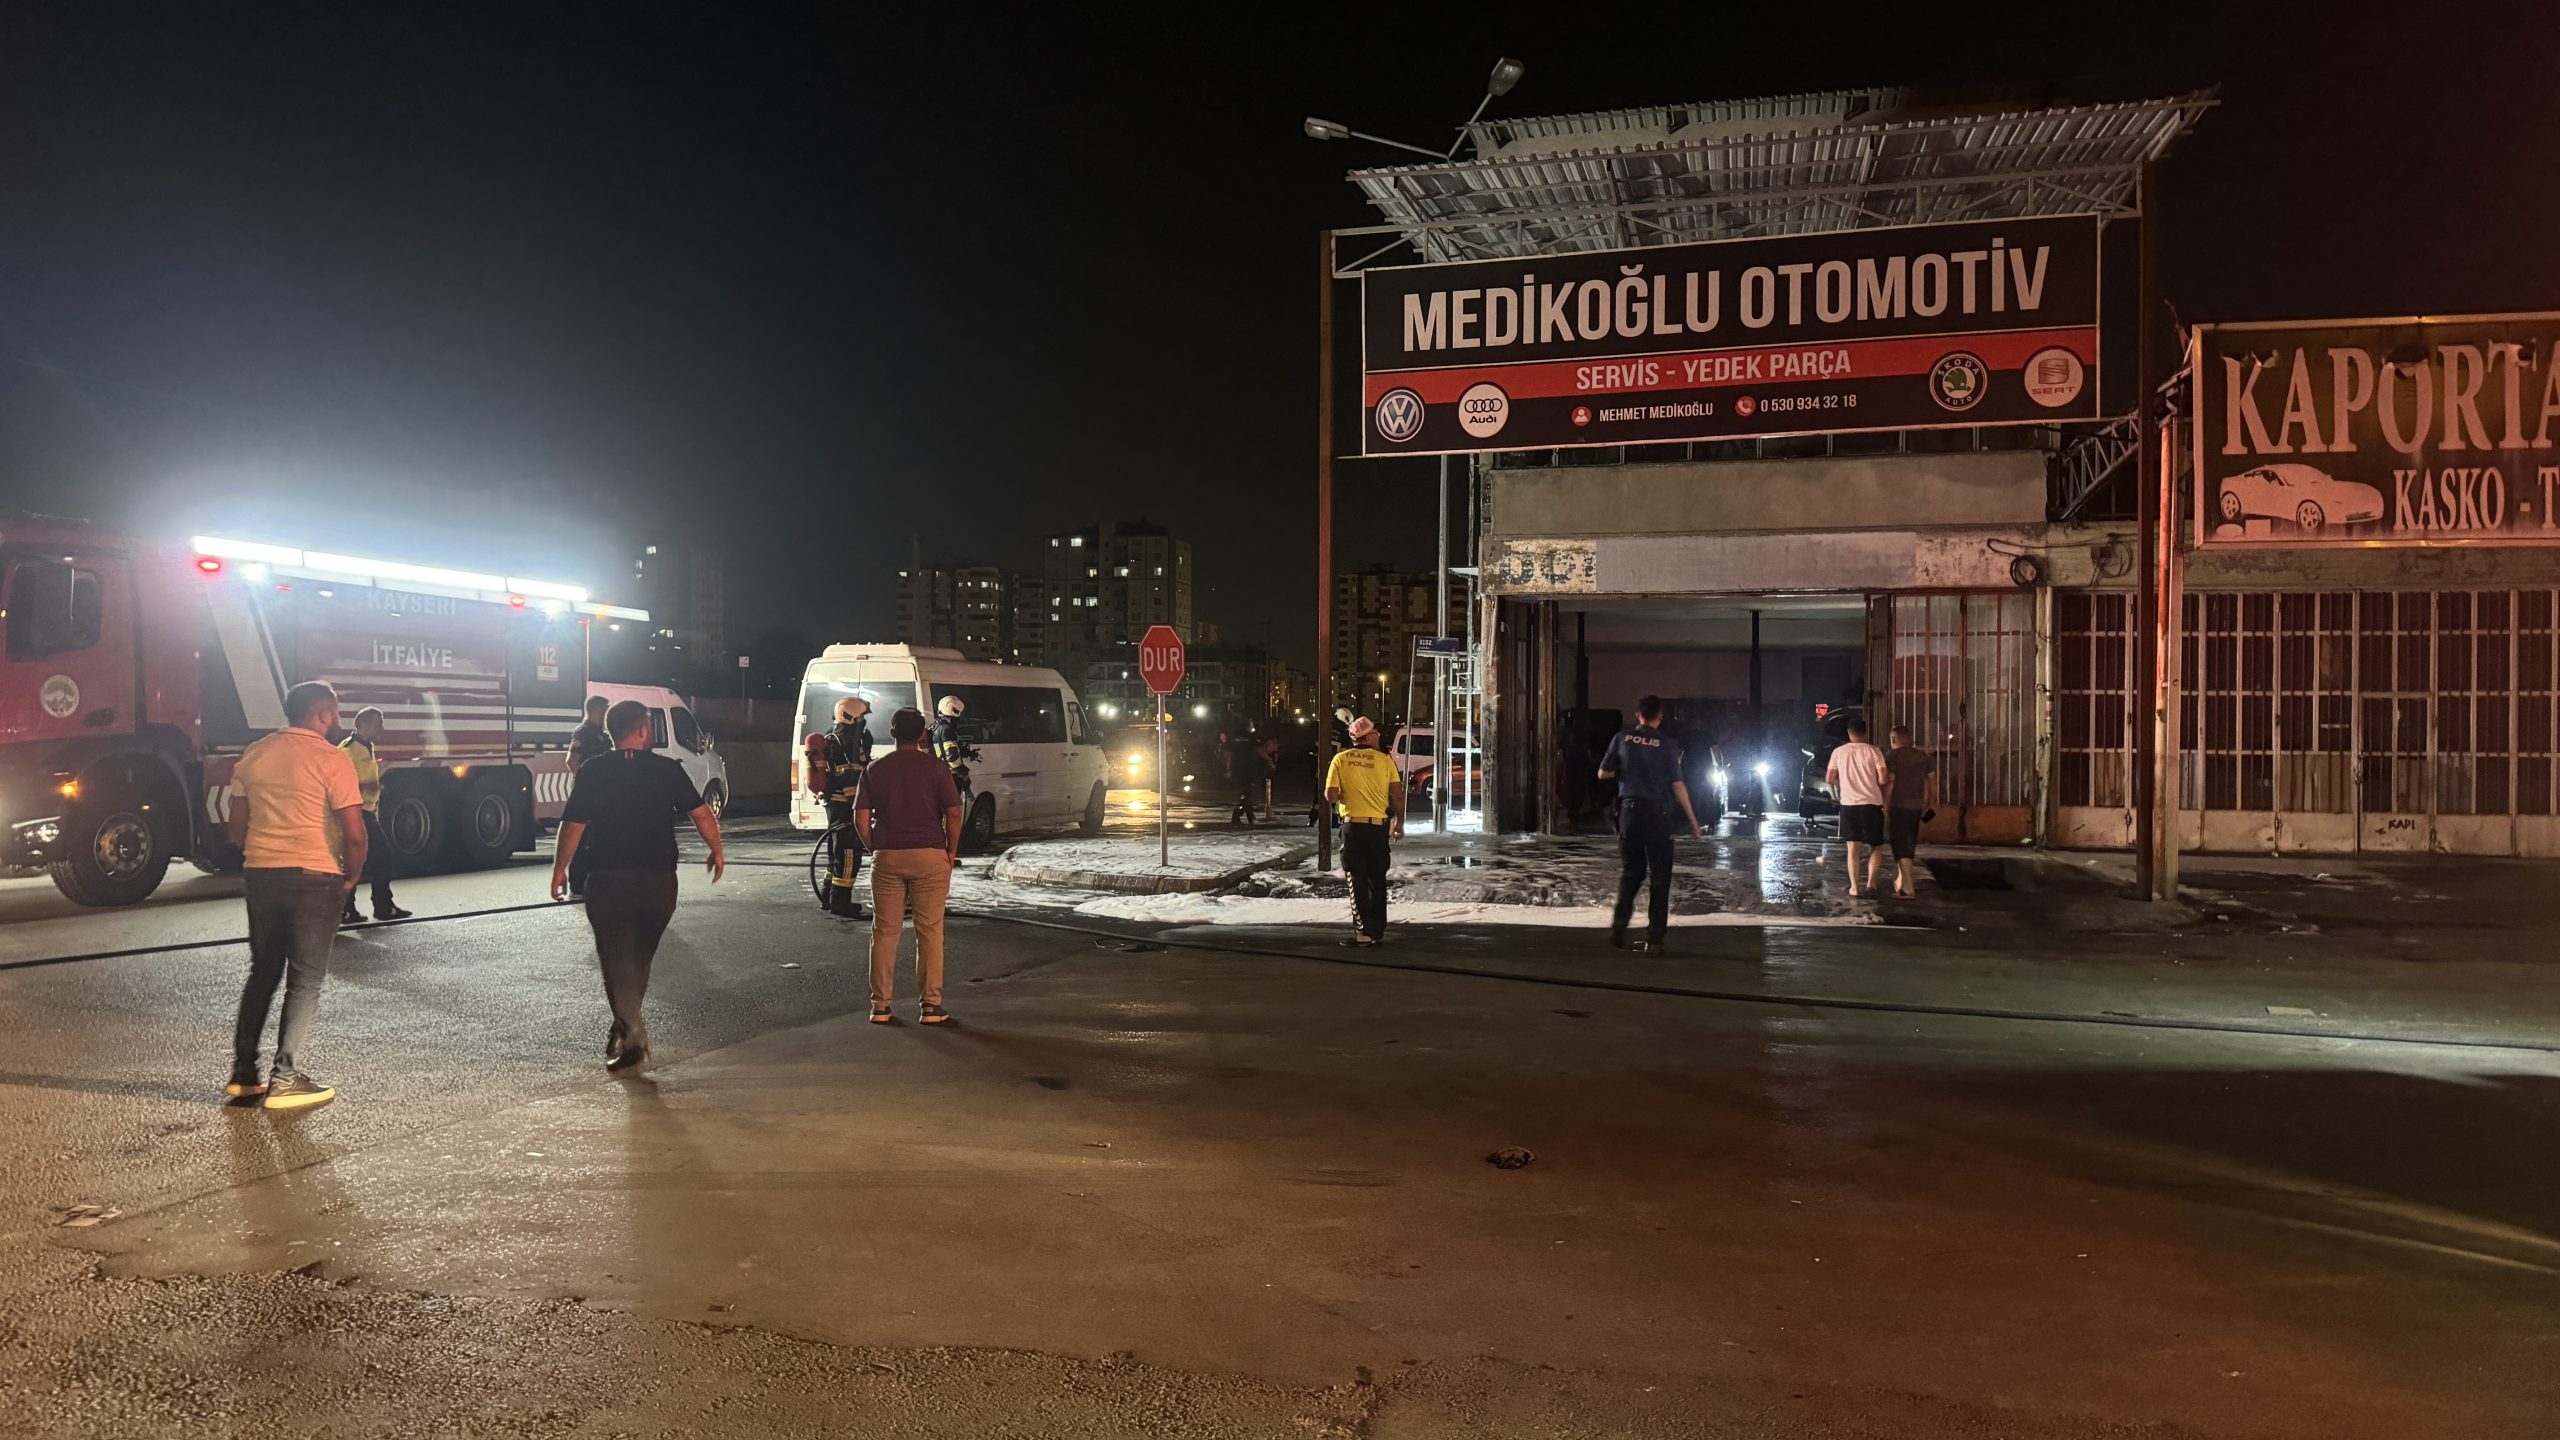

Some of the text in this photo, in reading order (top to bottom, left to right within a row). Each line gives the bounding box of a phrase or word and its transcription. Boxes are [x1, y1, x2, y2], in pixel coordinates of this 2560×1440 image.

[1403, 237, 2050, 352] MEDİKOĞLU OTOMOTİV
[1576, 359, 1659, 390] SERVİS
[1683, 355, 1762, 383] YEDEK
[1769, 350, 1851, 379] PARÇA
[2031, 386, 2076, 395] SEAT
[1599, 402, 1714, 422] MEHMET MEDİKOĞLU
[1760, 394, 1857, 412] 0 530 934 32 18
[1469, 415, 1497, 424] Audi
[2393, 466, 2505, 531] KASKO
[372, 640, 453, 668] İTFAİYE
[539, 646, 557, 665] 112
[1143, 647, 1180, 671] DUR
[2388, 818, 2415, 830] KAPI
